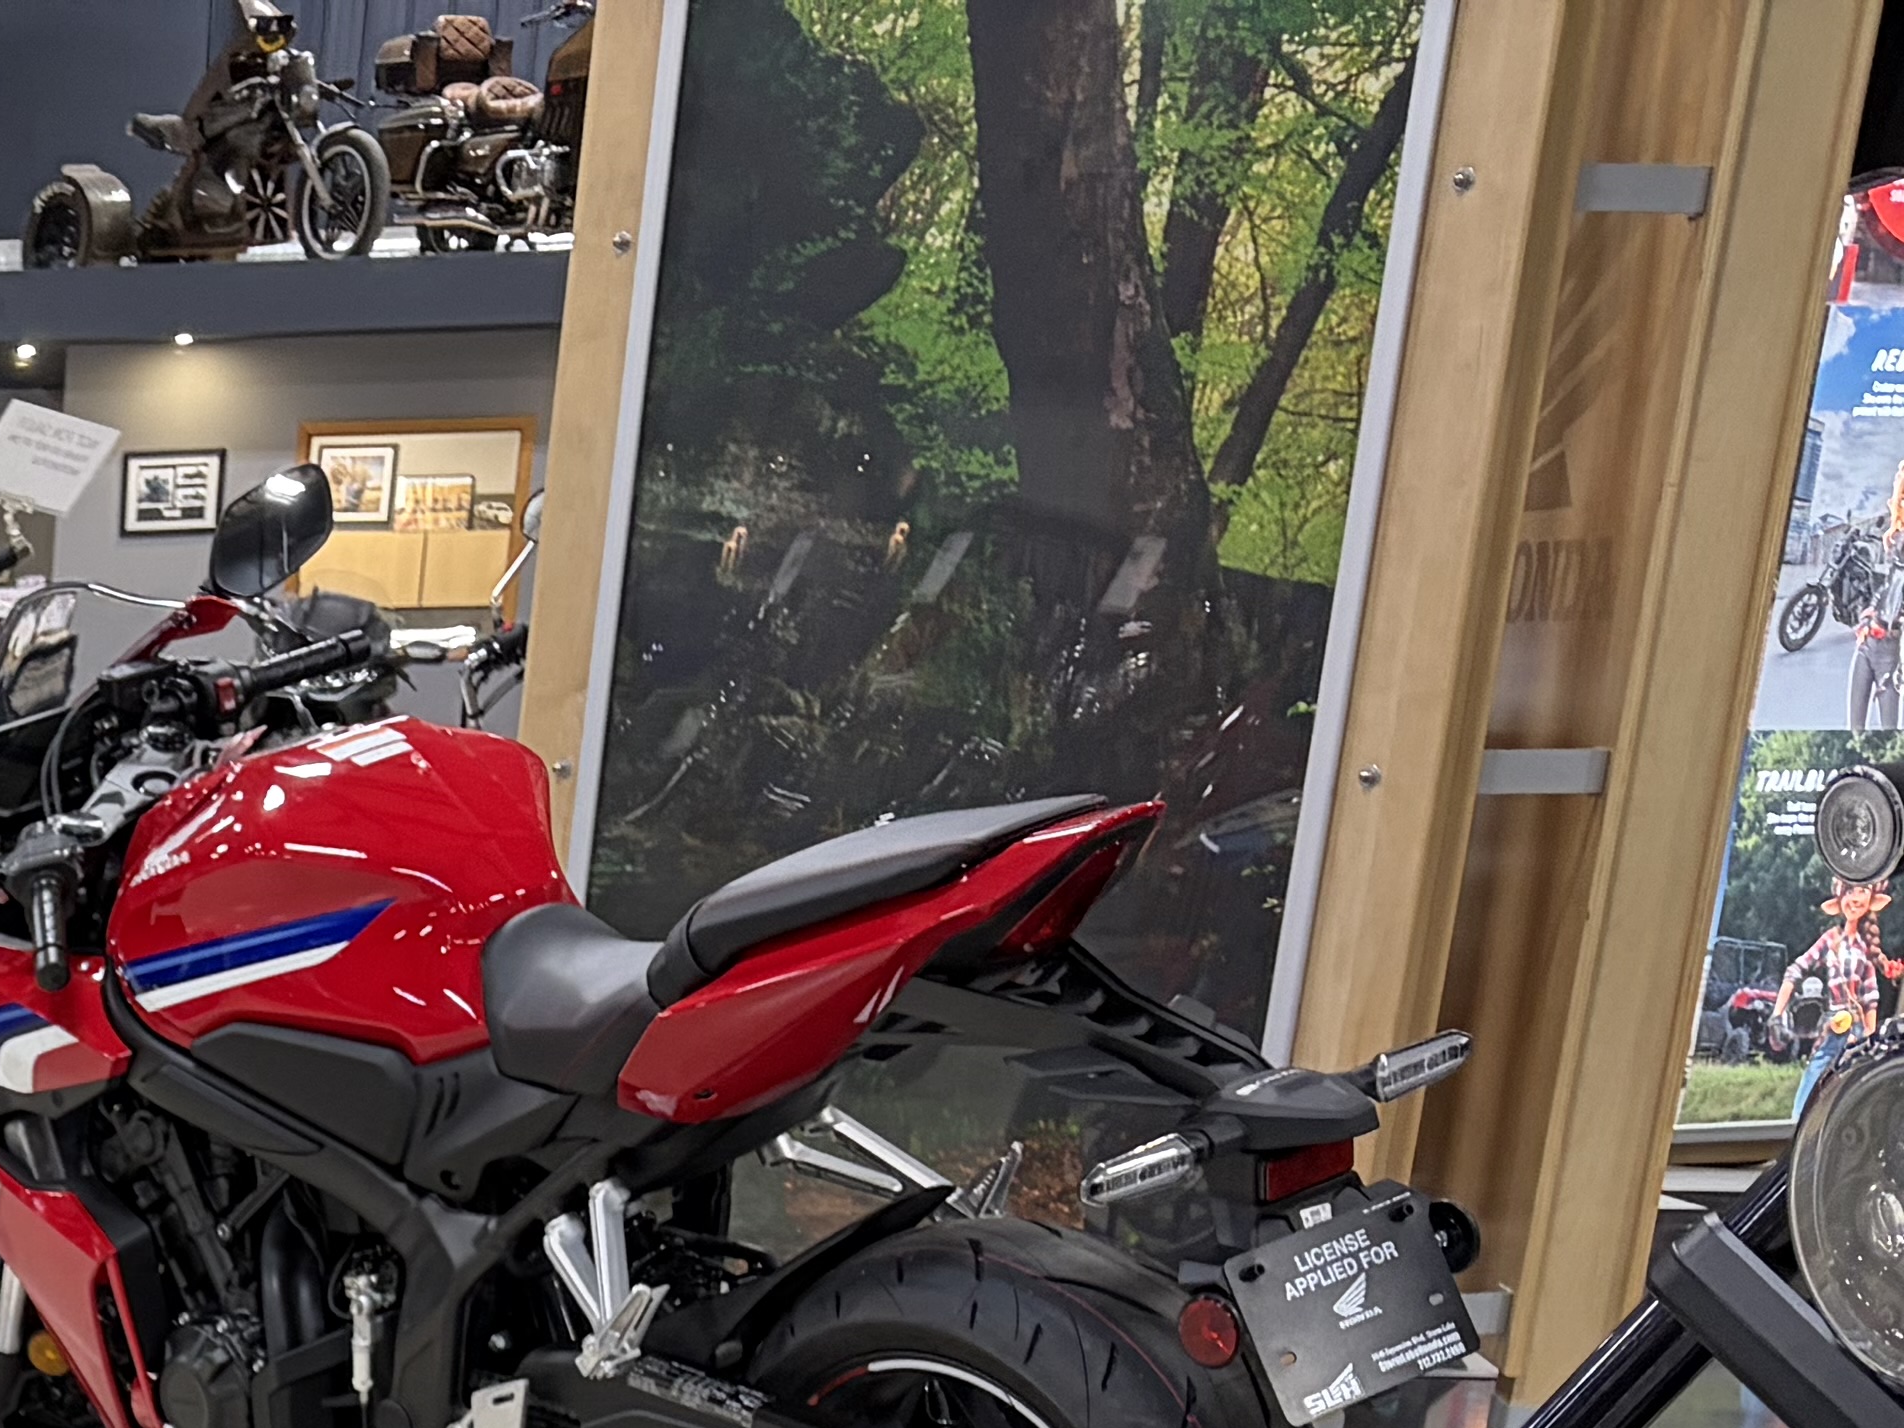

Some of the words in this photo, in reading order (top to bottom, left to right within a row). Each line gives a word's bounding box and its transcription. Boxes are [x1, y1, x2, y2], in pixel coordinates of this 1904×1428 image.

[1284, 1258, 1358, 1301] APPLIED
[1361, 1241, 1399, 1270] FOR
[1293, 1228, 1371, 1273] LICENSE
[1339, 1306, 1383, 1330] HONDA
[1303, 1376, 1365, 1416] SLH
